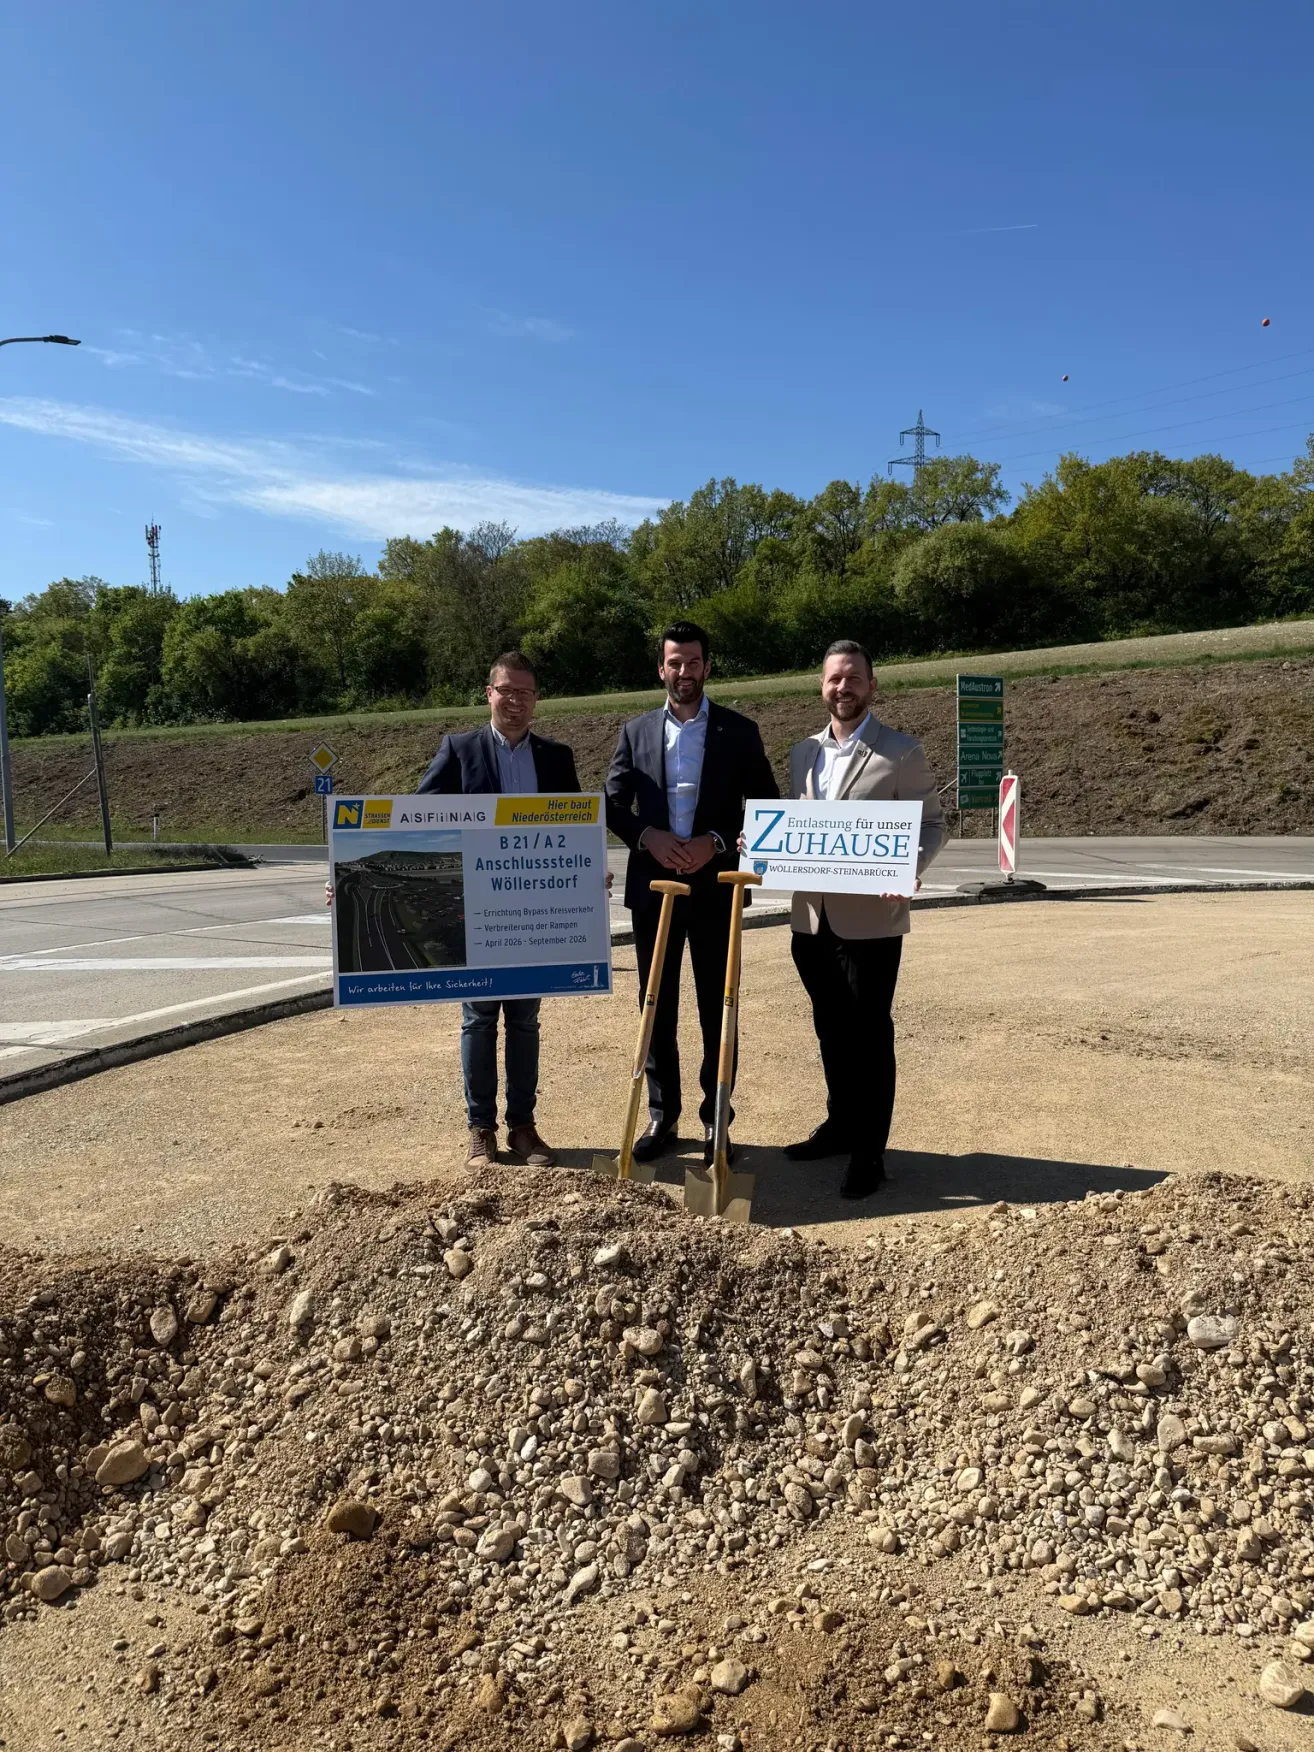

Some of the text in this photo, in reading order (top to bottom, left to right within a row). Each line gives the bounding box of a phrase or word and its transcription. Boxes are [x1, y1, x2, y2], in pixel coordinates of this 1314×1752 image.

[960, 681, 993, 692] MedAustron
[960, 751, 998, 761] Arena Nova
[317, 777, 331, 792] 21
[548, 798, 592, 811] Hier baut
[511, 811, 593, 823] Niederösterreich
[787, 817, 913, 832] Entlastung für unser
[750, 809, 911, 858] ZUHAUSE
[500, 832, 566, 850] B 21 / A 2
[475, 856, 592, 872] Anschlussstelle
[769, 864, 899, 878] WÖLLERSDORF-STEINABRÜCKL
[491, 875, 578, 891] Wöllersdorf
[483, 905, 595, 918] Errichtung Bypass Kreisverkehr
[484, 921, 578, 932] Verbreiterung der Rampen
[485, 938, 502, 948] April
[504, 938, 523, 947] 2026
[528, 936, 567, 946] September
[569, 935, 587, 943] 2026
[348, 977, 493, 994] Wir arbeiten für Ihre Sicherheit!
